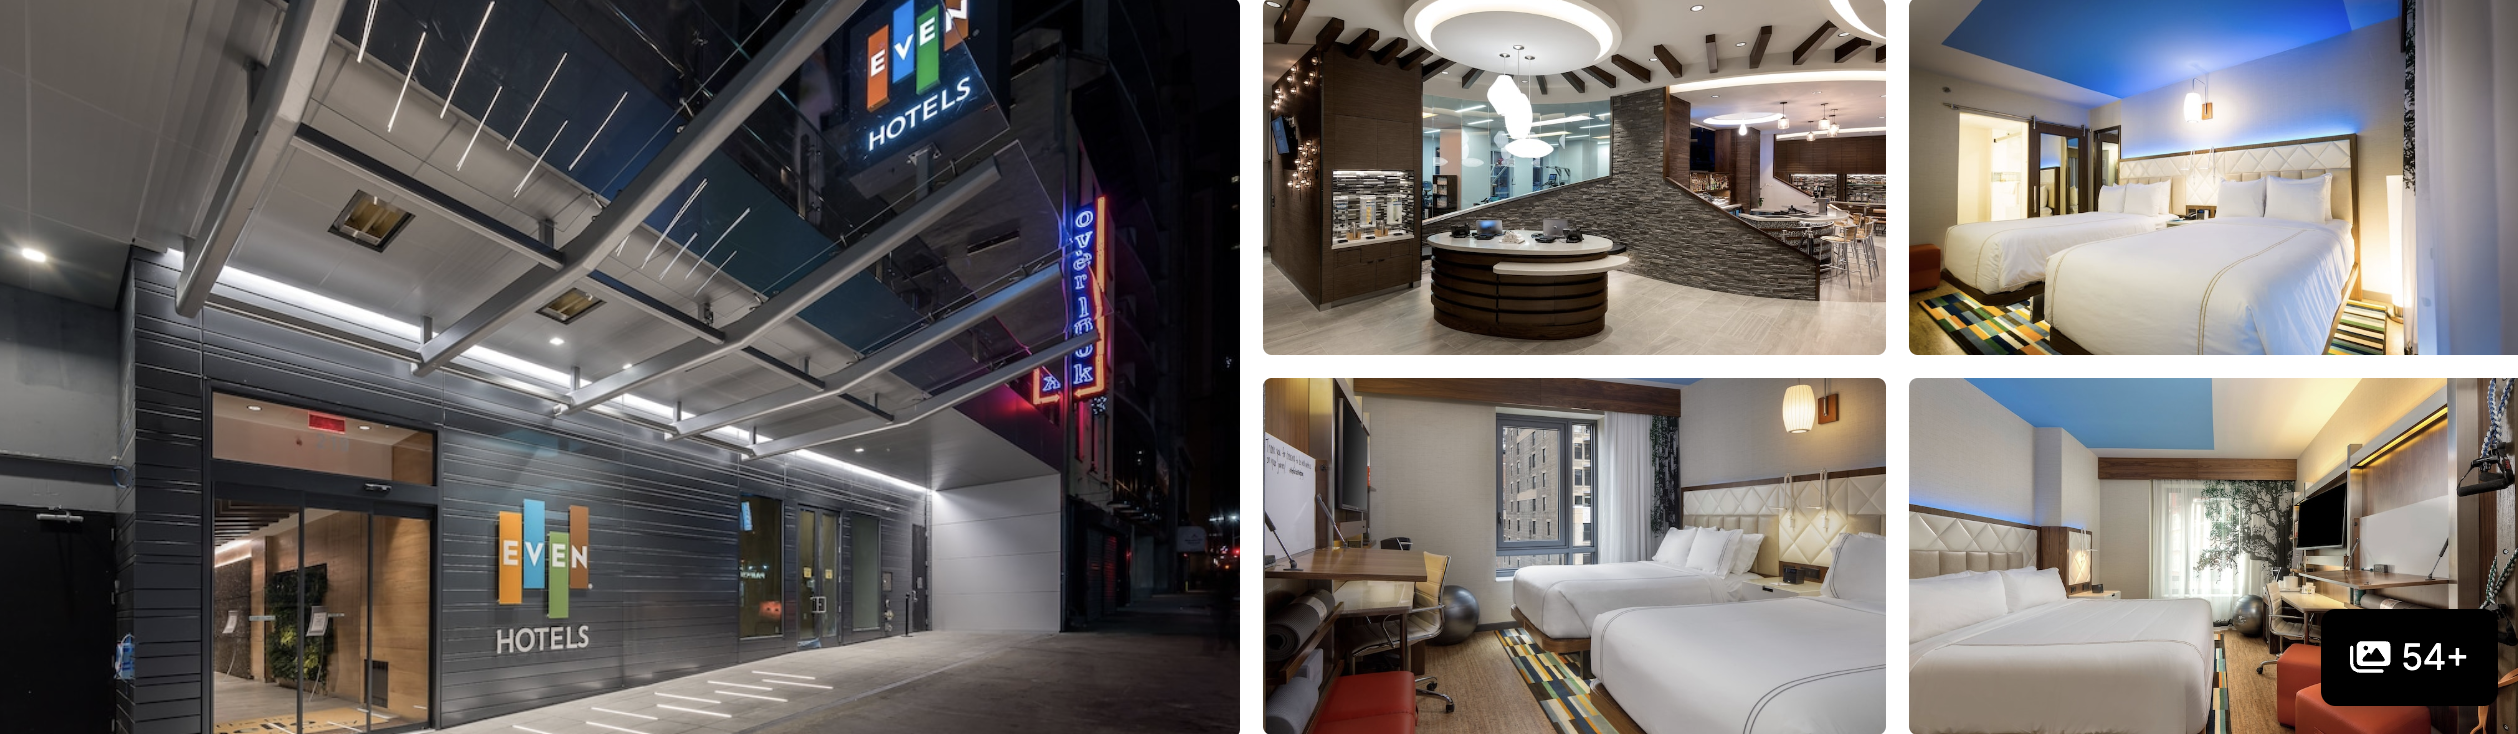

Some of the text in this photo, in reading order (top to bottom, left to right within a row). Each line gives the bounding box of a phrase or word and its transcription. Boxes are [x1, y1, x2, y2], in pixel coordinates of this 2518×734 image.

[870, 0, 968, 77] EVEN
[868, 76, 972, 152] HOTELS
[503, 539, 588, 569] EVEN
[496, 625, 590, 655] HOTELS
